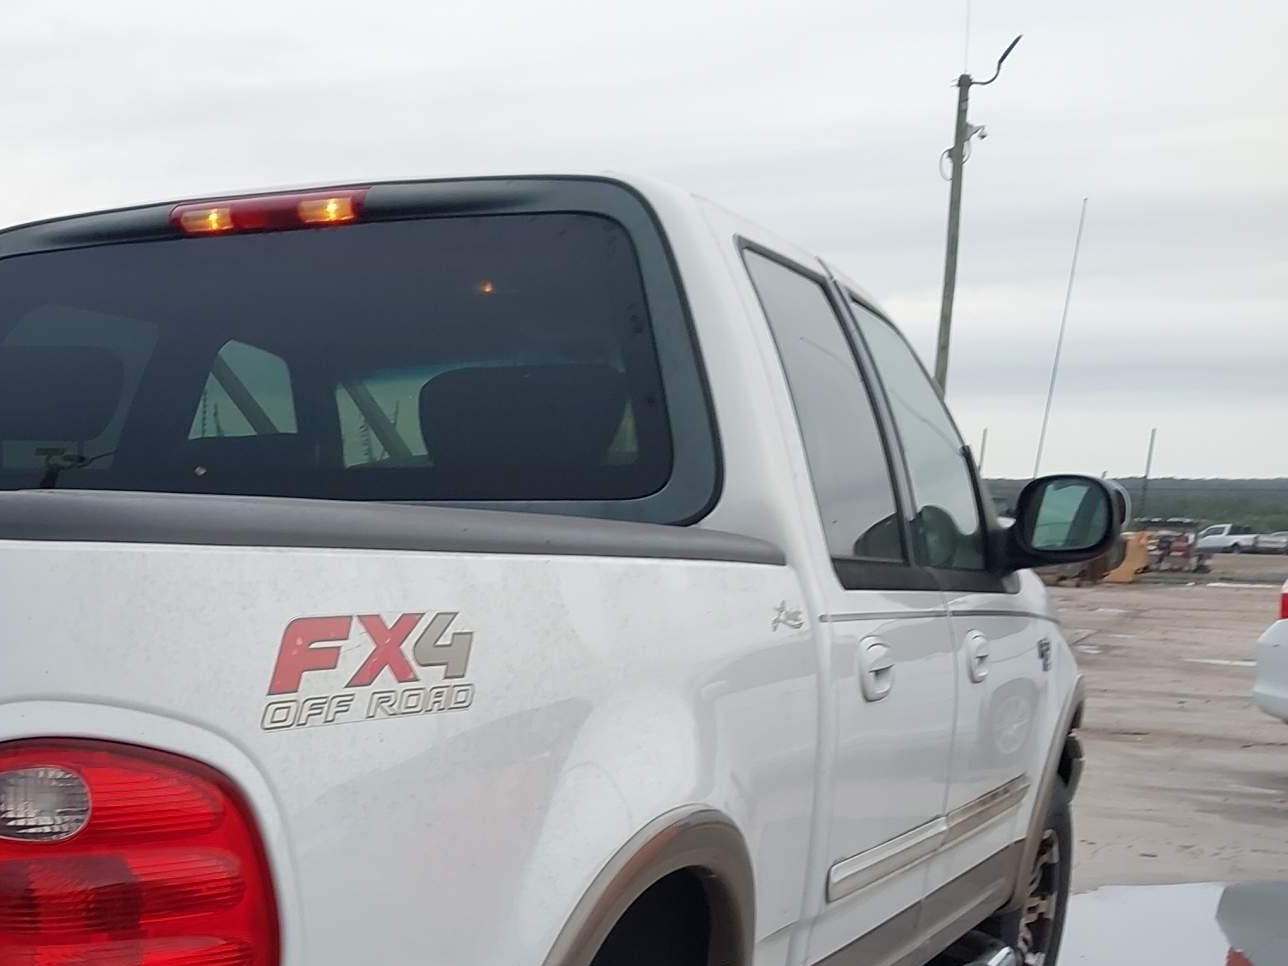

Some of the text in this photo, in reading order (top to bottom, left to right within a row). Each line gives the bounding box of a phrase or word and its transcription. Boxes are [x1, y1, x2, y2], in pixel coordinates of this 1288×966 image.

[266, 611, 474, 696] FX4
[261, 683, 474, 731] OFF ROAD
